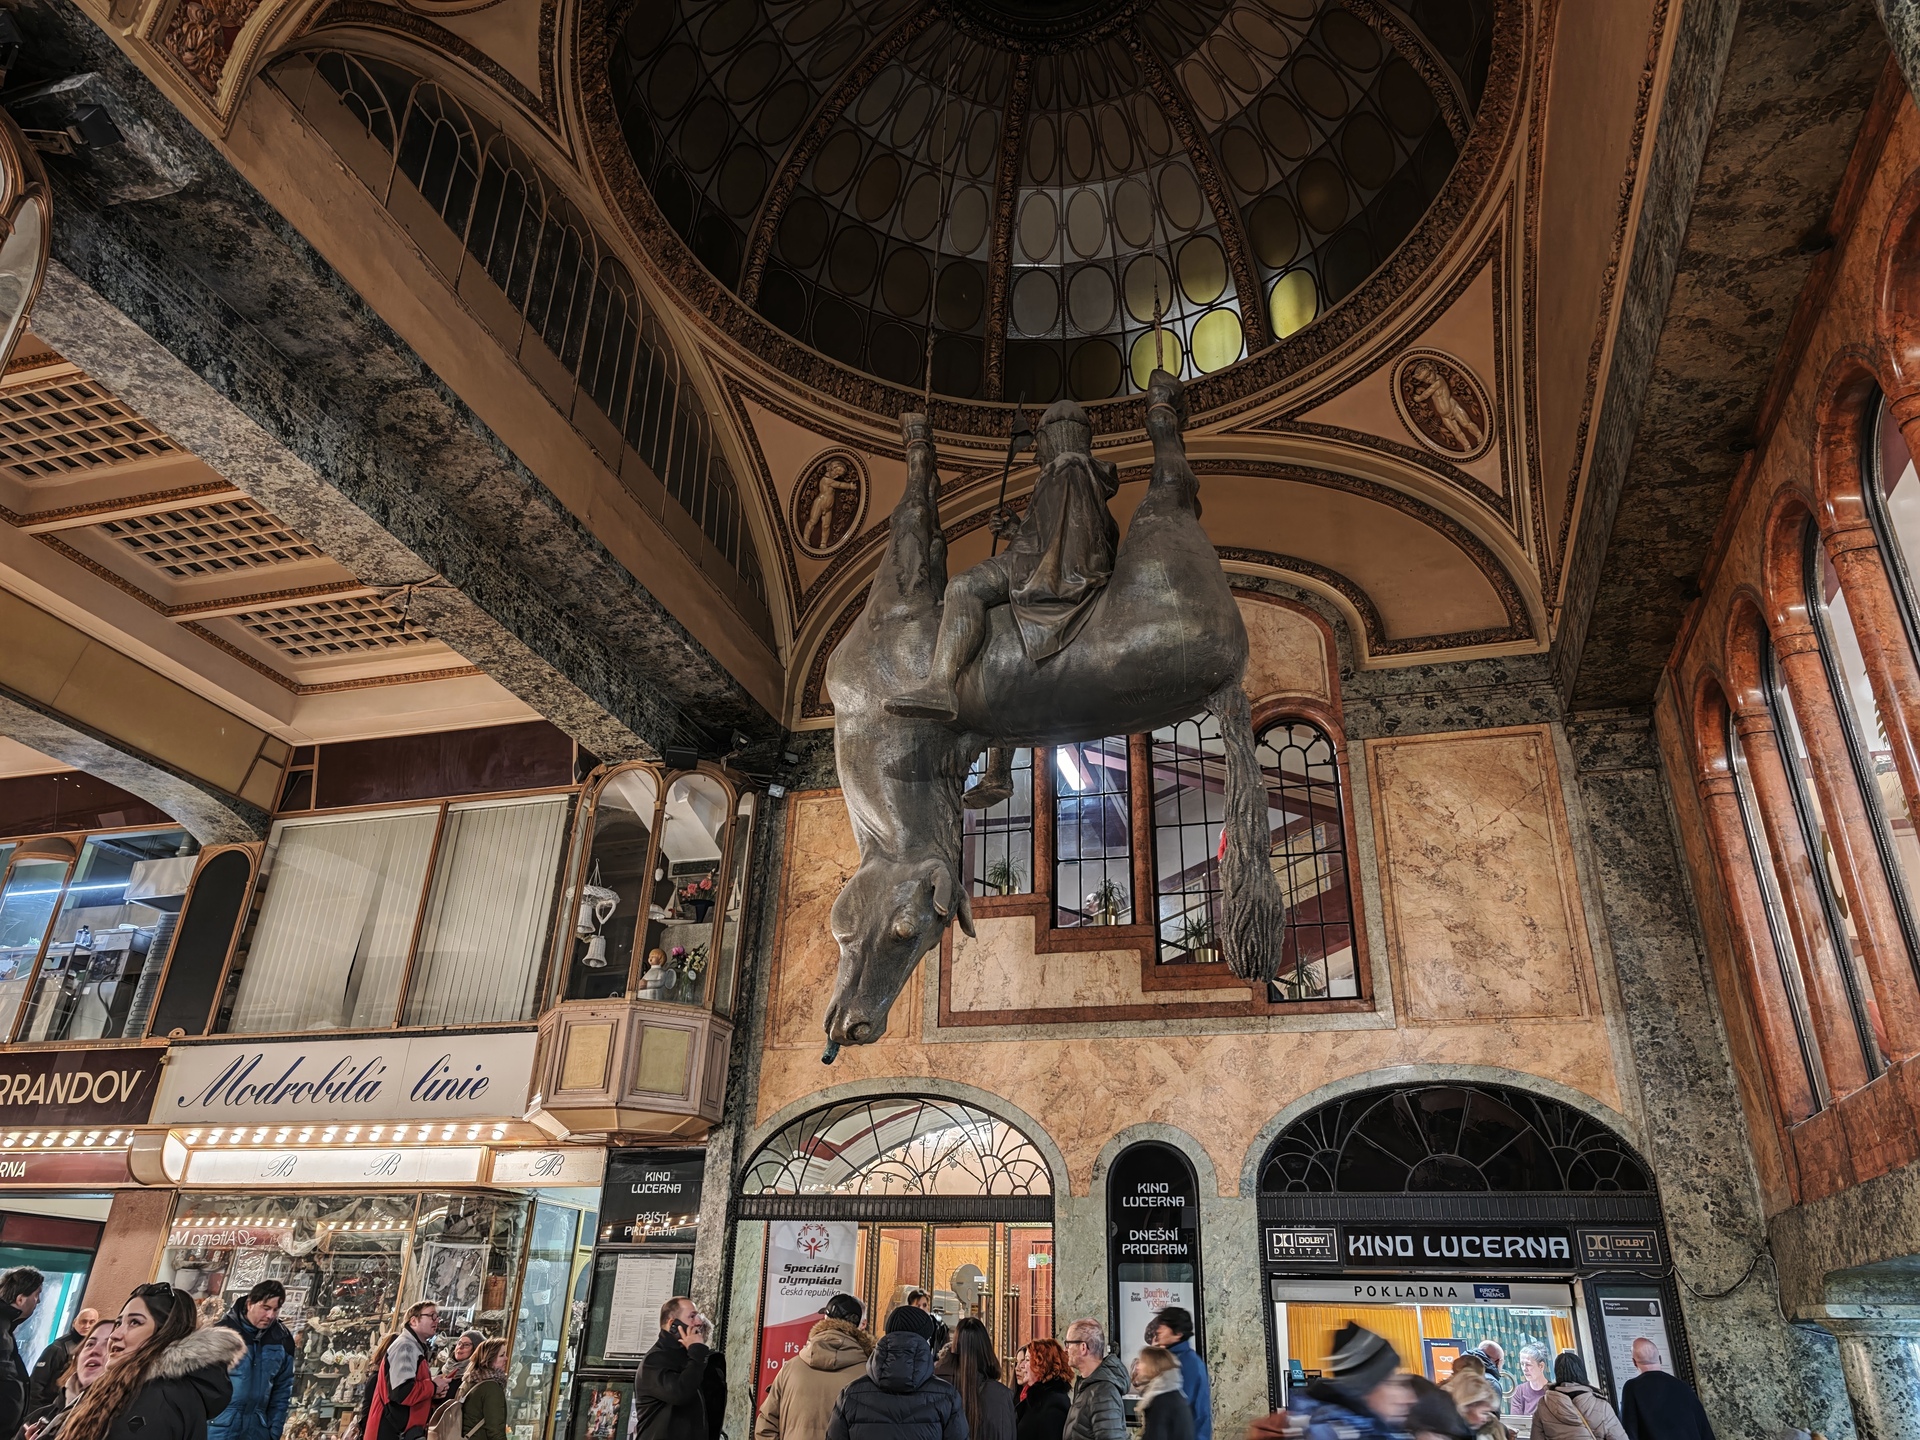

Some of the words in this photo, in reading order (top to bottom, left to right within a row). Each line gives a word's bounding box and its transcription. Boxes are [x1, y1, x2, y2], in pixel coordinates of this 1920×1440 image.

[410, 1053, 490, 1102] linie
[645, 1172, 670, 1182] KINO
[631, 1184, 682, 1194] LUCERNA
[1137, 1182, 1169, 1194] KINO
[1122, 1196, 1185, 1207] LUCERNA
[636, 1211, 670, 1225] PŘÍŠTÍ
[624, 1226, 677, 1236] PROGRAM
[1129, 1227, 1179, 1241] DNEŠNÍ
[1298, 1236, 1325, 1244] DOLBY
[1615, 1239, 1646, 1247] DOLBY
[1121, 1243, 1188, 1255] PROGRAM
[1348, 1235, 1414, 1257] KINO
[1423, 1235, 1570, 1258] LUCERNA
[1588, 1250, 1653, 1259] DIGITAL
[783, 1263, 840, 1275] Speciální
[778, 1275, 842, 1287] olympiáda
[780, 1286, 804, 1296] Česká
[804, 1287, 841, 1298] republika
[1354, 1286, 1457, 1298] POKLADNA
[784, 1342, 799, 1353] it's
[767, 1358, 778, 1369] to
